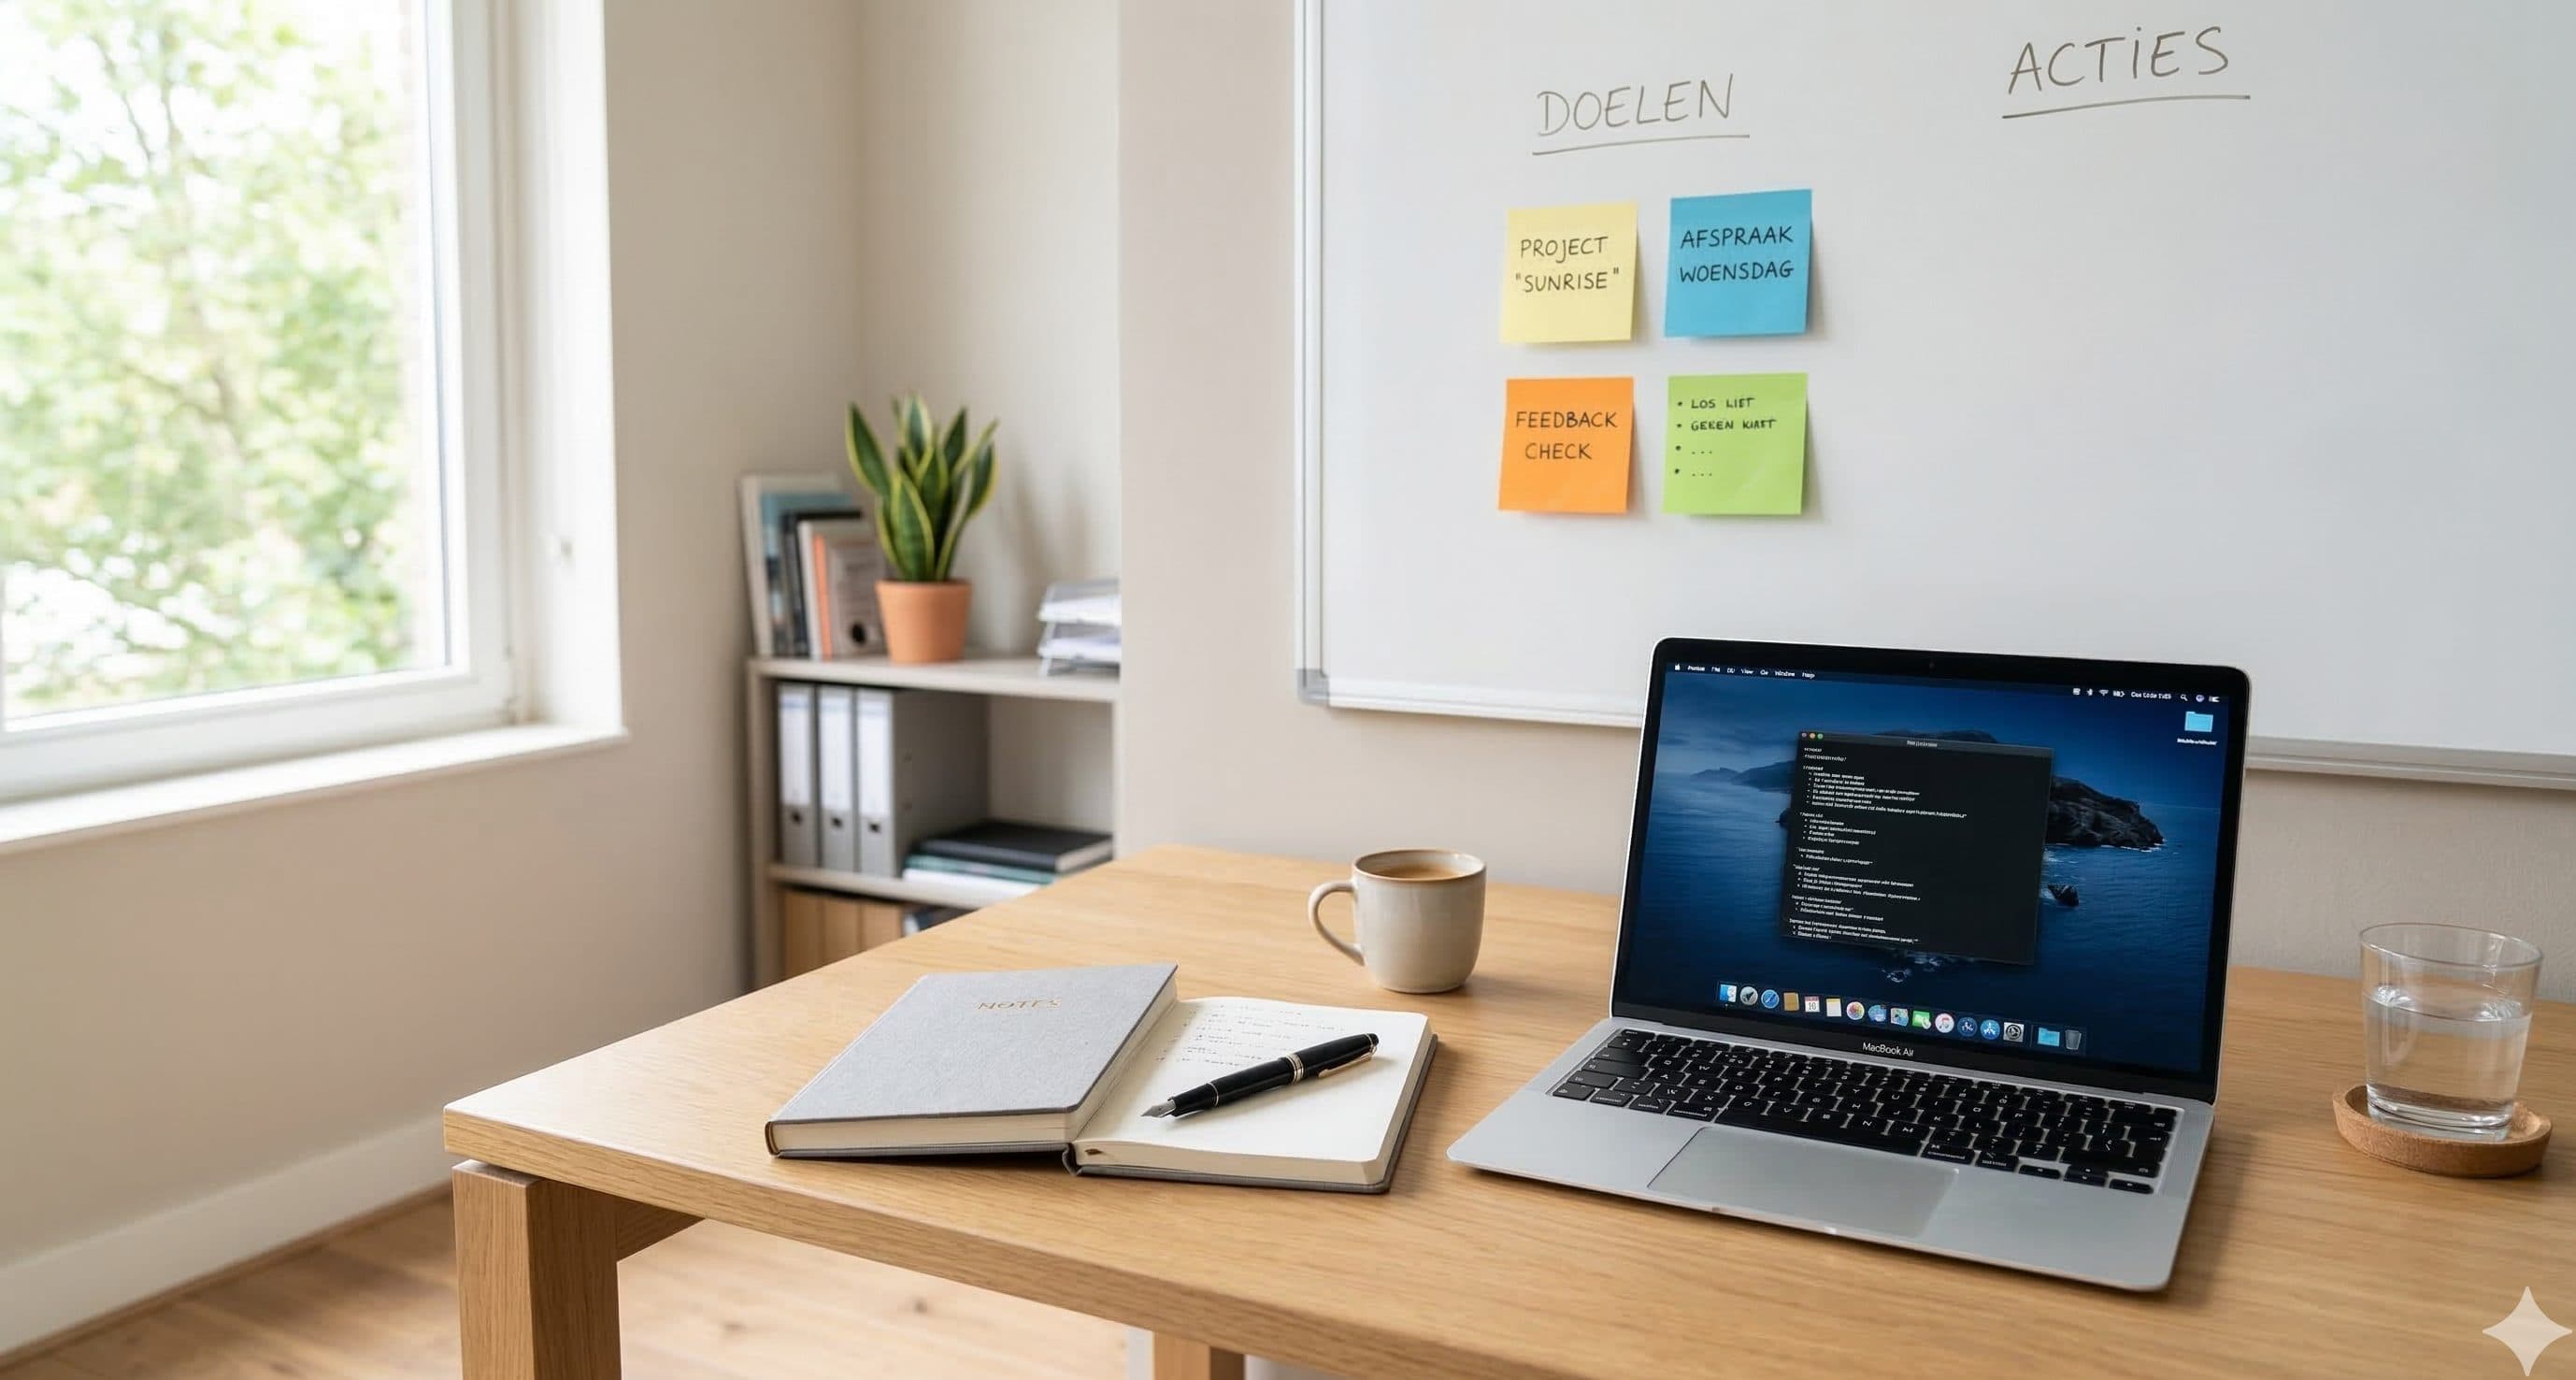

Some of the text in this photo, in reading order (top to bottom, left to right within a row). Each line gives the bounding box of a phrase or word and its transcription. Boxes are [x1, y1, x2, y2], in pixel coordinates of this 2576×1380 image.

[1537, 73, 1734, 137] DOELEN
[1680, 225, 1795, 249] AFSPRAAK
[1520, 236, 1610, 264] PROJECT
[1515, 266, 1620, 294] "SUNRISE"
[1680, 260, 1795, 283] WOENSDAG
[1691, 398, 1716, 410] LOS
[1515, 411, 1619, 429] FEEDBACK
[1524, 442, 1593, 460] CHECK
[1862, 1041, 1901, 1057] MacBook
